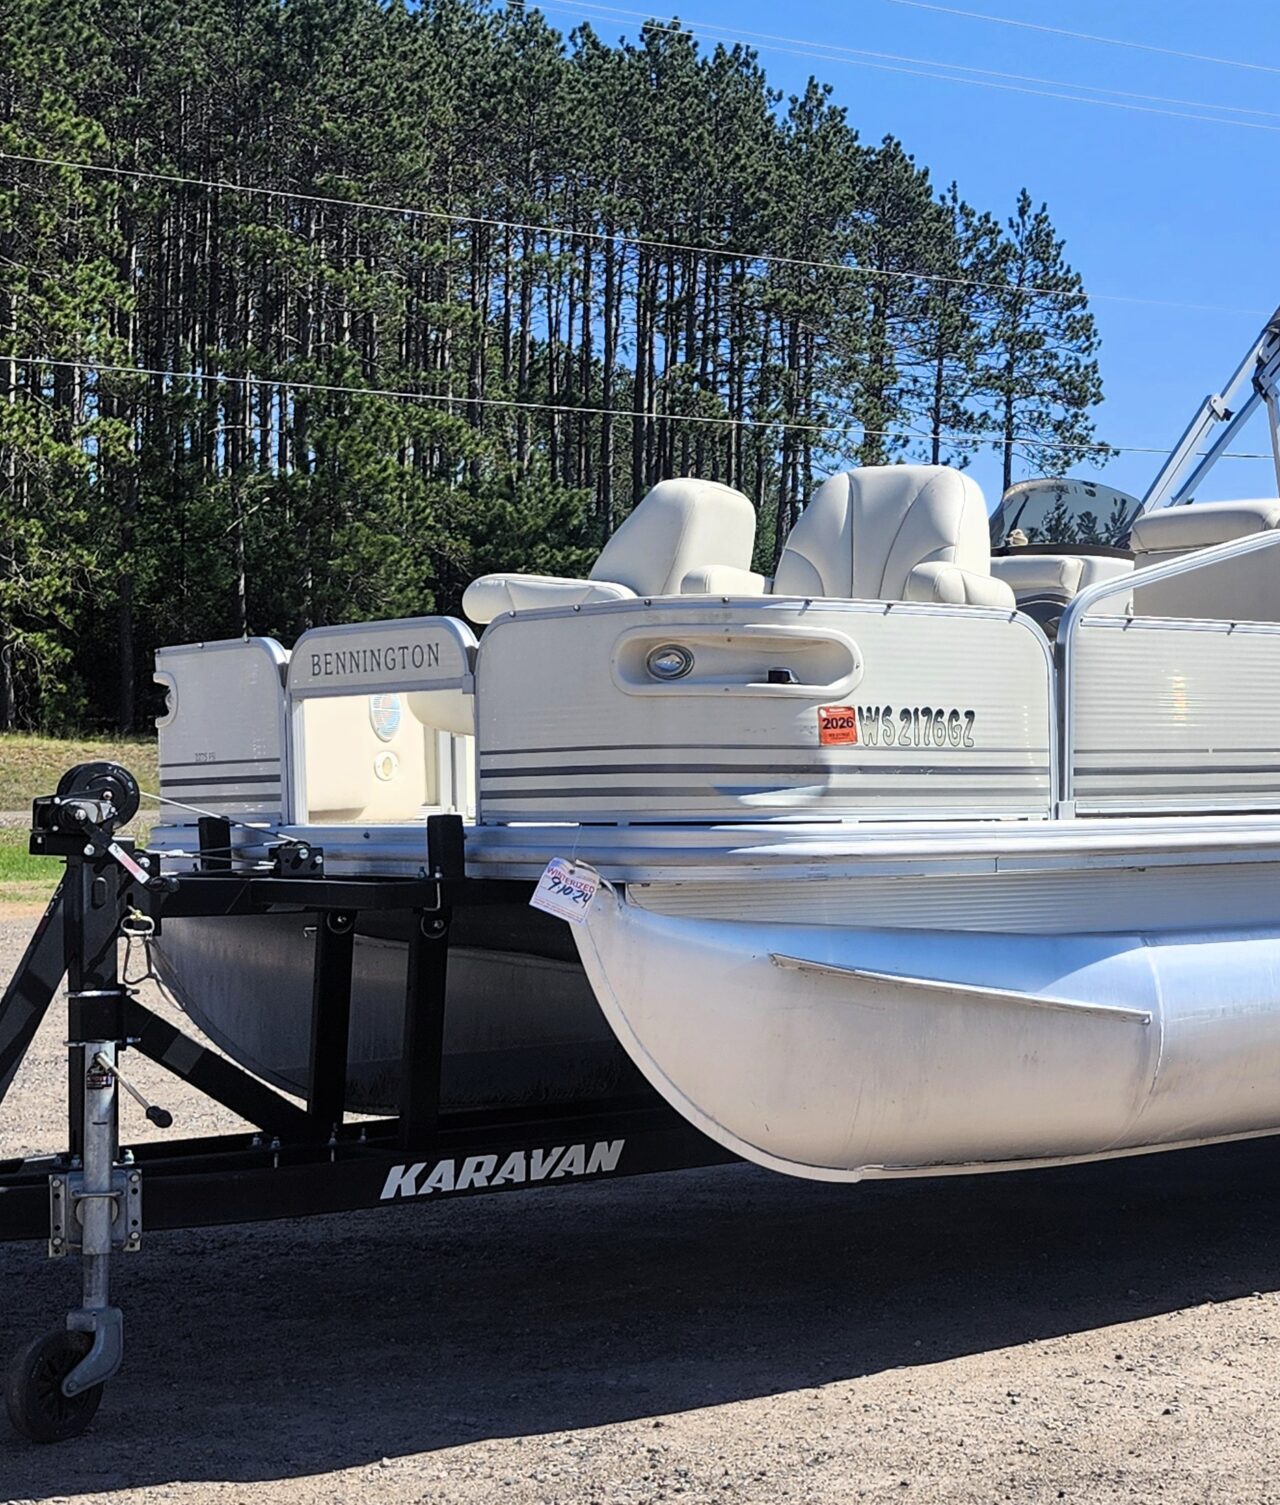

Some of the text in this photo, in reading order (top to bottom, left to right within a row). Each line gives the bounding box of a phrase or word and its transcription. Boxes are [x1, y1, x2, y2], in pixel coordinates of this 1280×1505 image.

[311, 643, 440, 676] BENNINGTON
[822, 717, 854, 730] 2026
[547, 866, 595, 893] WINTERIZED
[380, 1139, 626, 1200] KARAVAN
